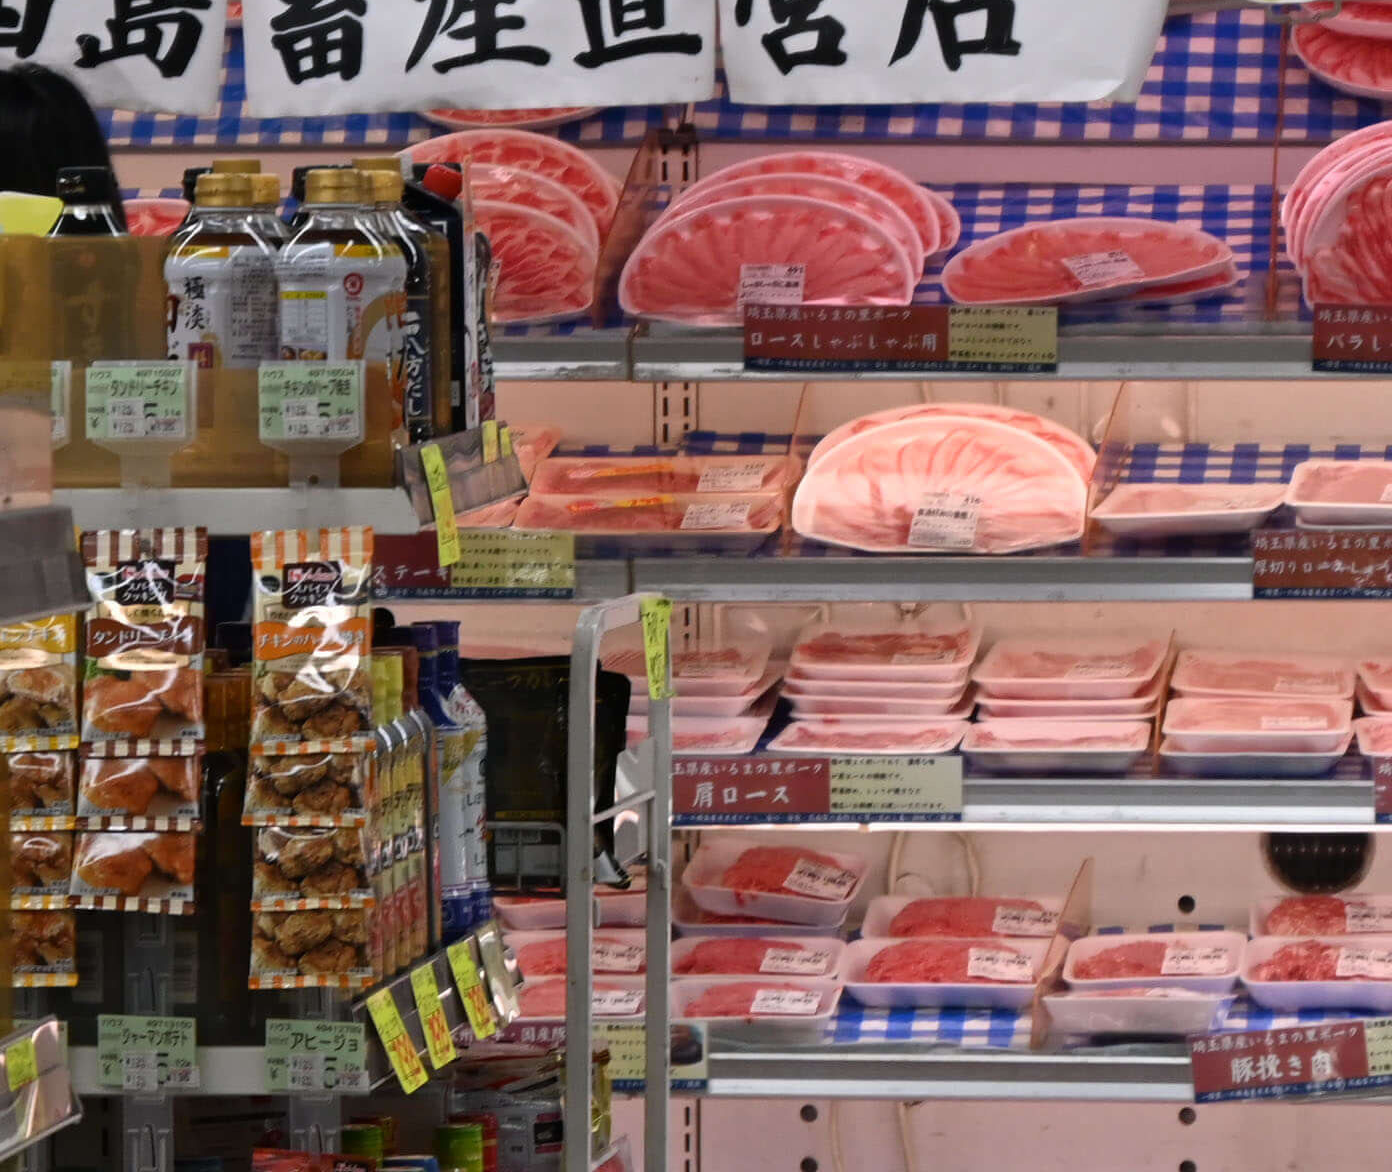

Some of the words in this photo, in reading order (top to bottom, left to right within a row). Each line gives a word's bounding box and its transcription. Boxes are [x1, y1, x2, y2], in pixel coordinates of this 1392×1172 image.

[750, 331, 939, 352] ロースしゃぶしゃぶ用
[691, 781, 790, 808] 肩ロース
[290, 1031, 359, 1052] アヒージョ
[1230, 1049, 1335, 1083] 豚挽き肉
